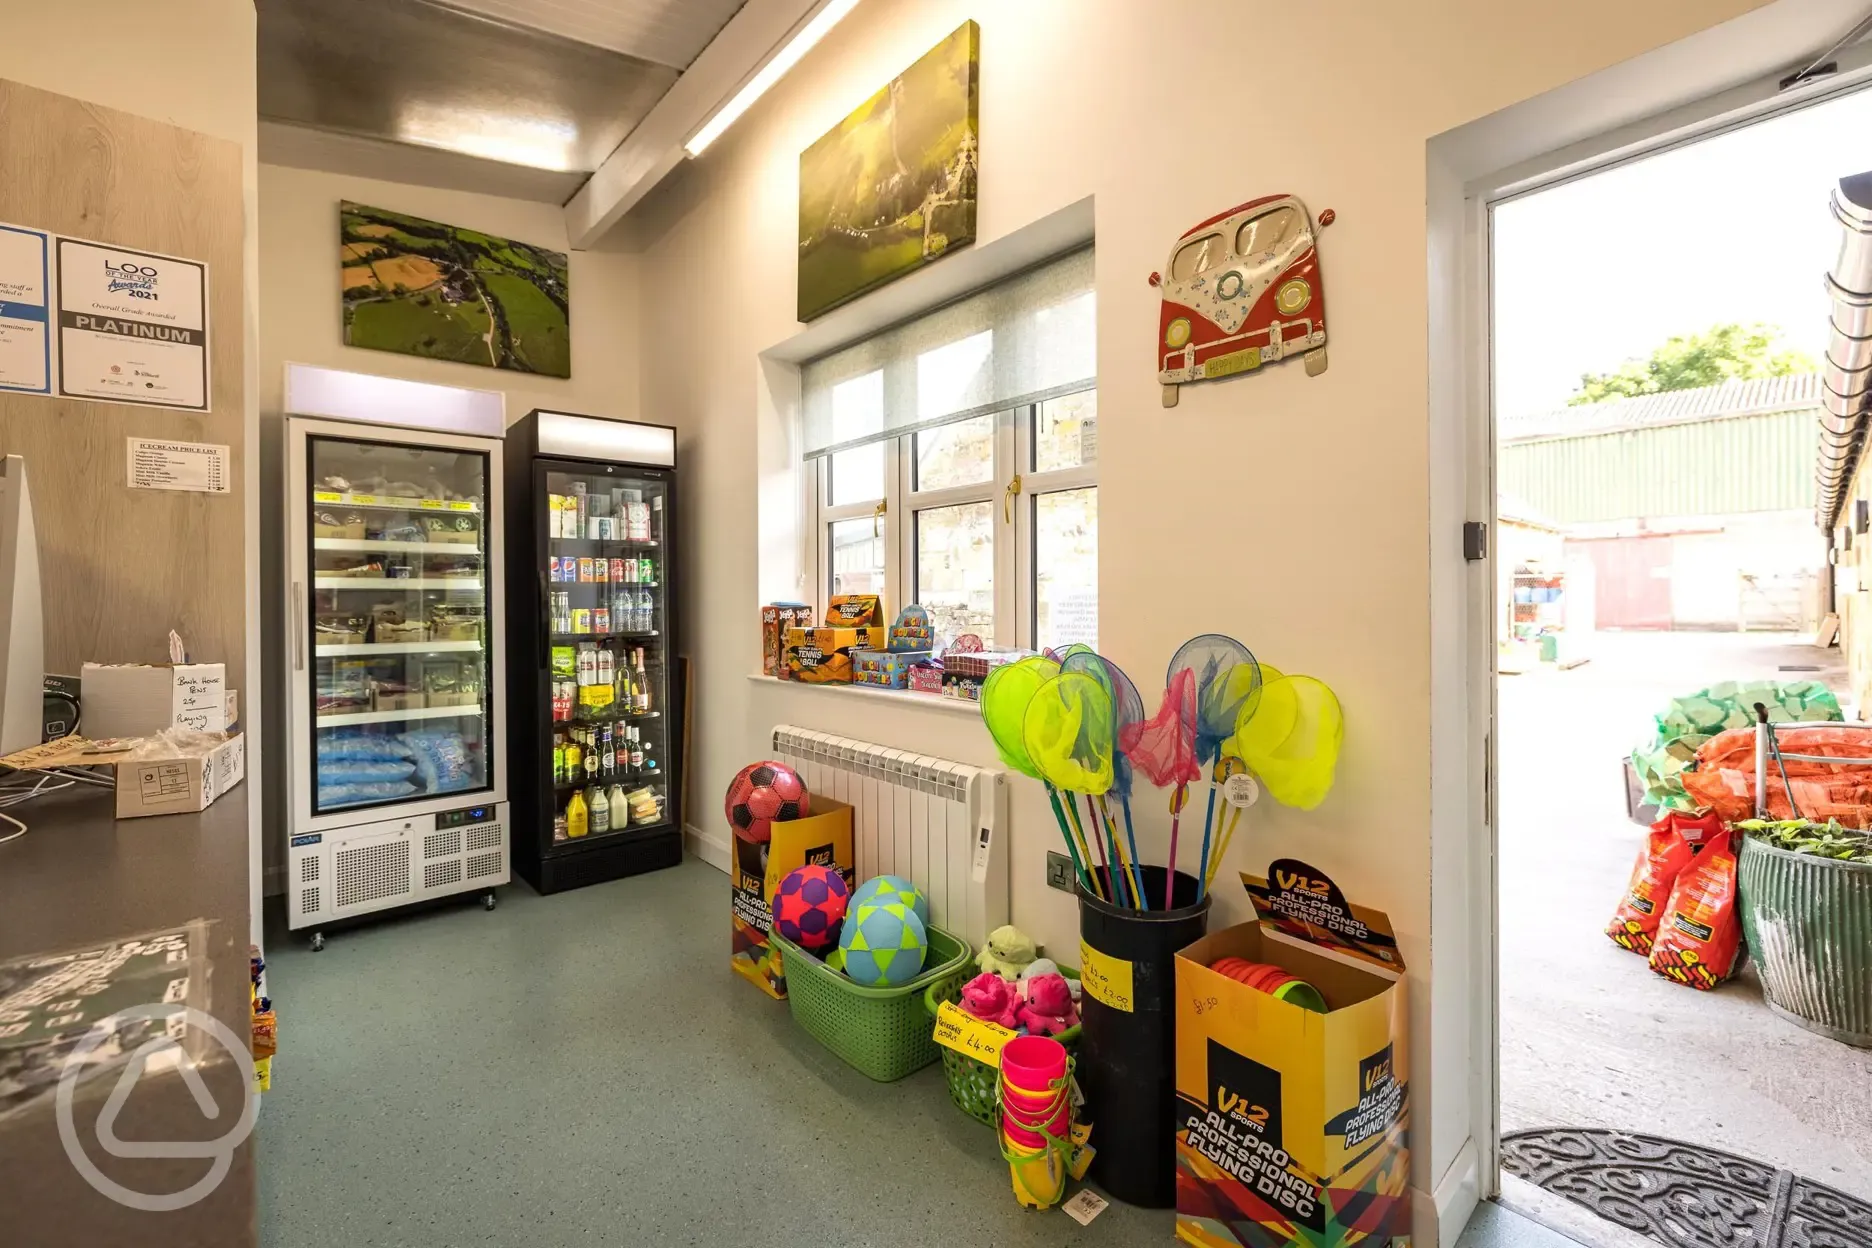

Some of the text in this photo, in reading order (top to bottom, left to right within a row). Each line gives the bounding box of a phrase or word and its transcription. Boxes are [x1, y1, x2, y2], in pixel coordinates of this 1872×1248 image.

[104, 260, 158, 277] LOO
[137, 276, 158, 284] YEAR
[108, 278, 153, 292] Awards
[128, 289, 158, 300] 2021
[92, 303, 120, 312] Overall
[76, 315, 191, 343] PLATINUM
[798, 650, 822, 659] TENNIS
[802, 659, 819, 667] BALL
[810, 850, 831, 865] V12
[742, 875, 761, 891] V12
[1276, 869, 1331, 896] V12
[1293, 888, 1329, 901] SPORTS
[734, 897, 774, 924] PROFESSIONA
[739, 891, 768, 910] ALL-PRO
[1281, 891, 1343, 916] ALL-PRO
[734, 908, 771, 932] FLYING DIS
[1268, 895, 1369, 931] PROFESSIONAL
[1272, 903, 1369, 939] FLYING DISC
[966, 1033, 995, 1054] £4.00
[1365, 1059, 1390, 1092] V12
[1217, 1085, 1270, 1127] V12
[1358, 1076, 1395, 1113] ALL-PRO
[1230, 1111, 1264, 1133] SPORTS
[1345, 1096, 1401, 1148] FLYING DISC
[1206, 1111, 1289, 1167] ALL-PRO
[1186, 1116, 1317, 1203] PROFESSIONAL
[1187, 1132, 1314, 1218] FLYING DISC
